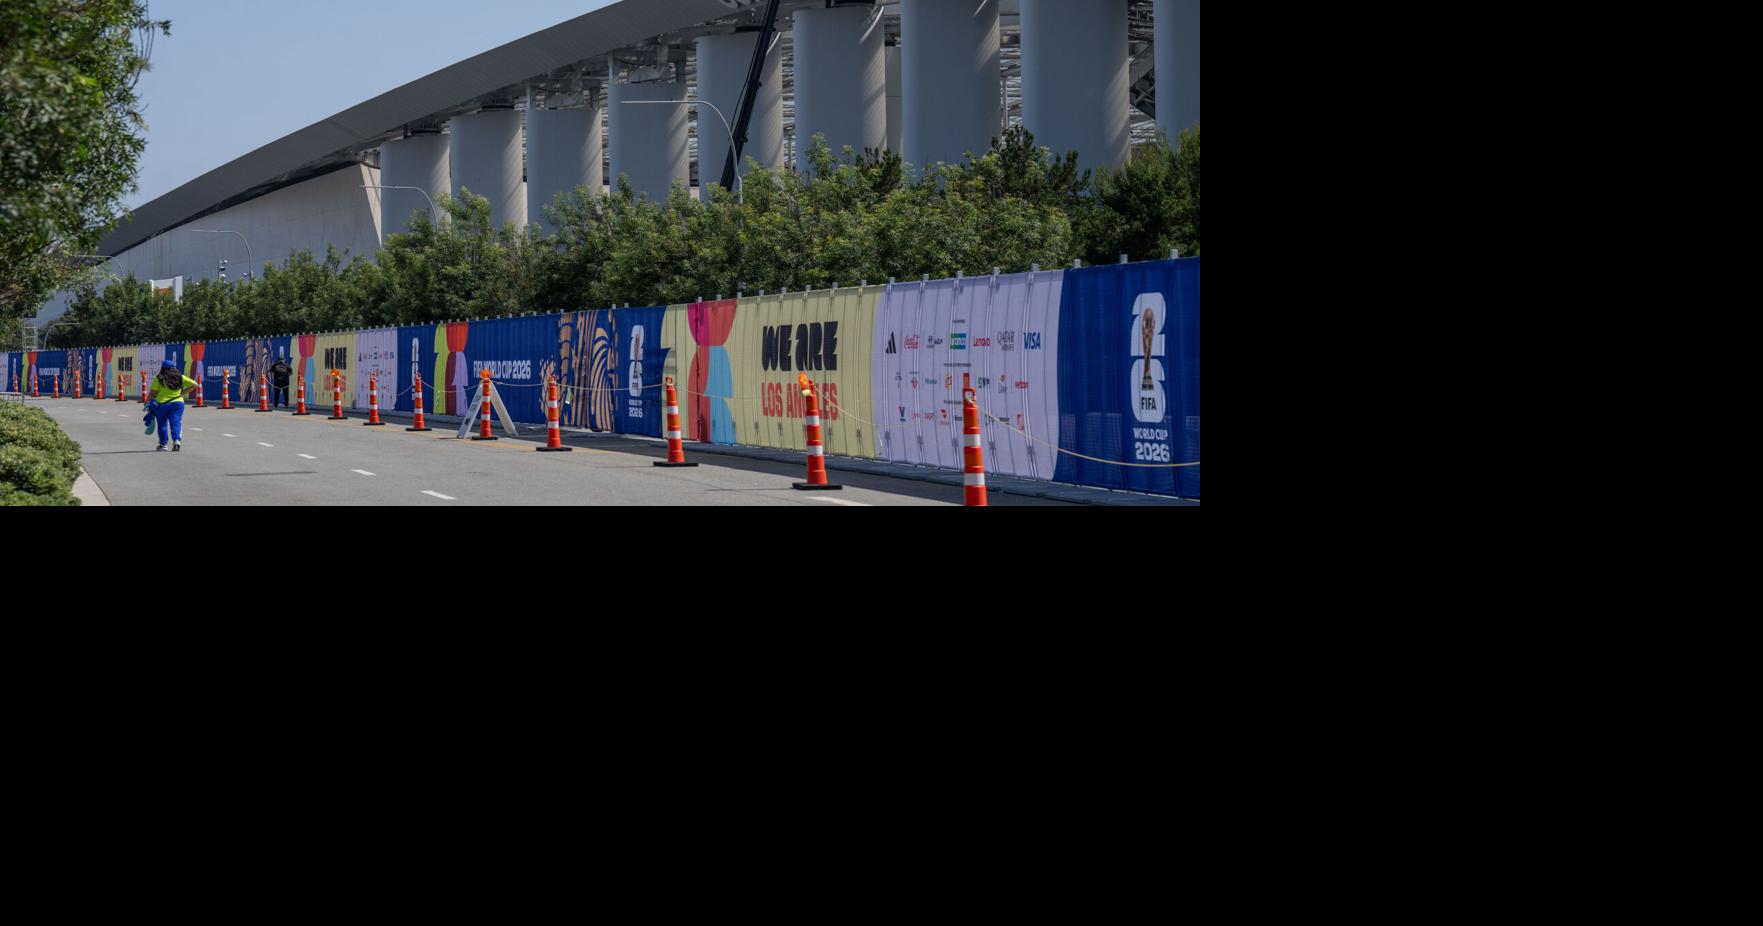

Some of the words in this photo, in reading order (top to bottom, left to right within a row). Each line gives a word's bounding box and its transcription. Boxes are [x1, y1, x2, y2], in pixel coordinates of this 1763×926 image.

[761, 324, 792, 371] WE
[795, 321, 838, 371] ARE
[973, 335, 991, 347] Lenovo
[997, 331, 1015, 345] QATAR
[1023, 332, 1041, 350] VISA
[502, 360, 512, 379] CUP
[512, 359, 531, 379] 2026
[761, 382, 783, 417] LOS
[786, 383, 839, 421] ANLES
[1141, 397, 1157, 411] FIFA
[1133, 427, 1155, 439] WORLD
[1155, 429, 1168, 441] CUP
[1135, 442, 1170, 462] 2026
